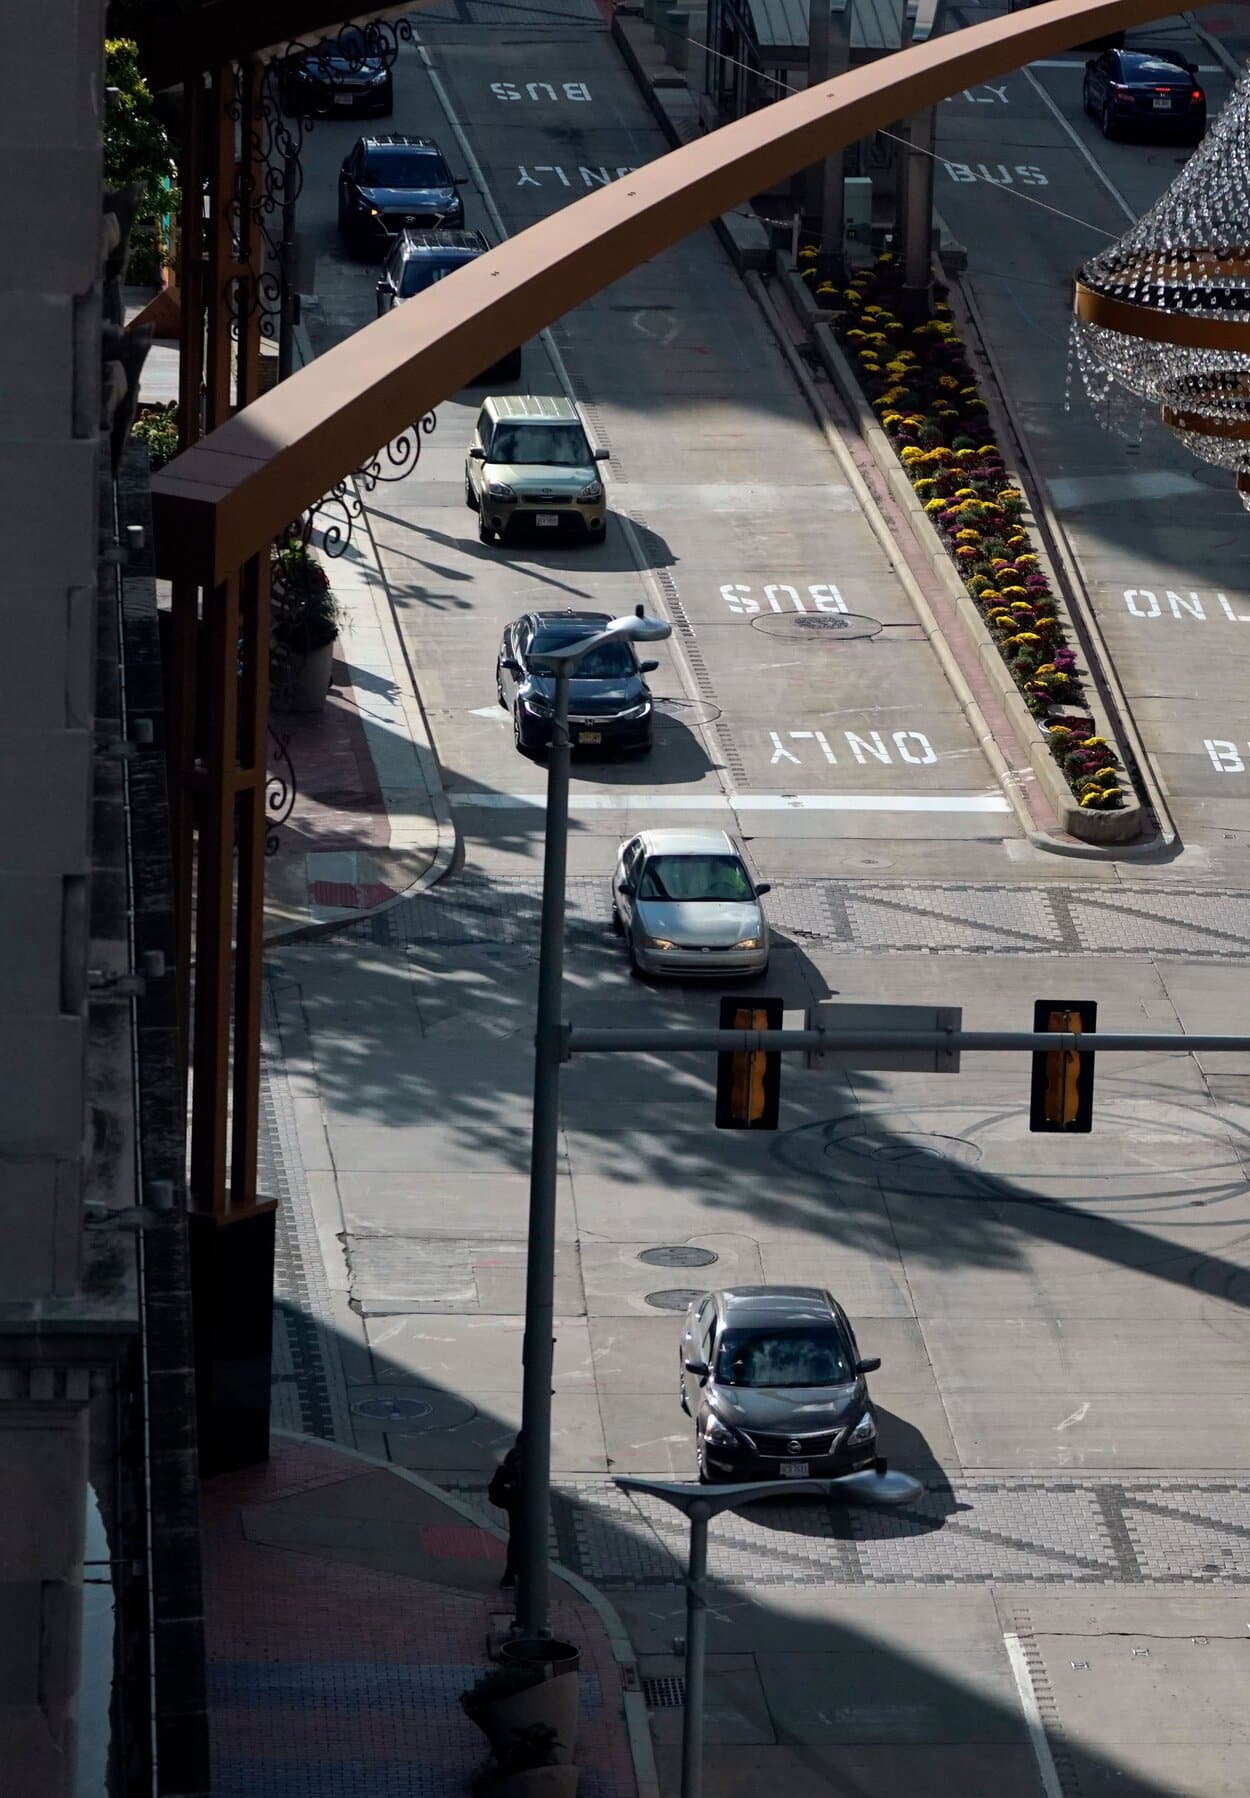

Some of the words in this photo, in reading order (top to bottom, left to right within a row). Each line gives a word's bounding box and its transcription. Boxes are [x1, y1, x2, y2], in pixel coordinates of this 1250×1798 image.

[490, 82, 593, 101] BUS
[943, 163, 1049, 185] BUS
[719, 584, 849, 614] BUS
[768, 731, 938, 764] ONLY
